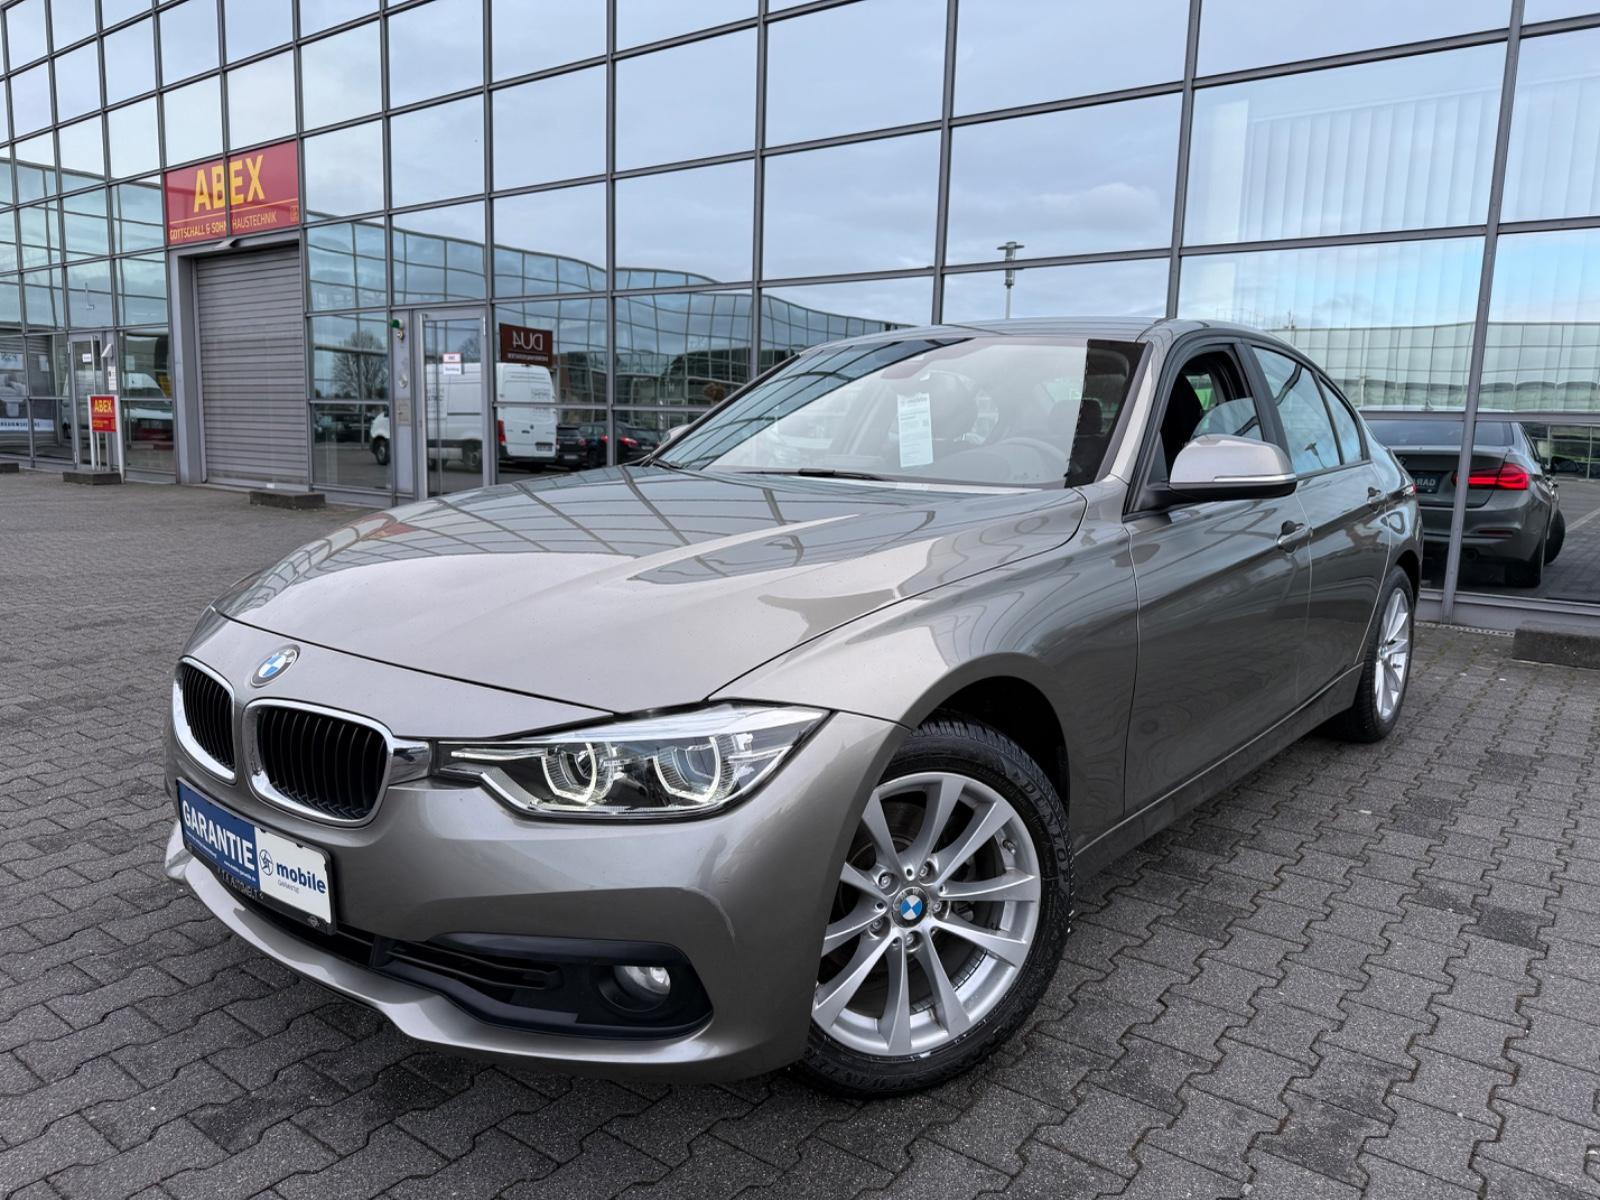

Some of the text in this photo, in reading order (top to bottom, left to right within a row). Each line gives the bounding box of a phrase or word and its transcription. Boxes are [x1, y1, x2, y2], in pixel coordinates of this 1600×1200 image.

[194, 154, 265, 213] ABEX
[169, 224, 205, 240] GOTTSCHALL
[206, 223, 210, 234] &
[232, 211, 277, 230] HAUSTECHNIK
[94, 400, 113, 413] ABEX
[182, 800, 255, 872] GARANTIE
[276, 862, 326, 894] mobile
